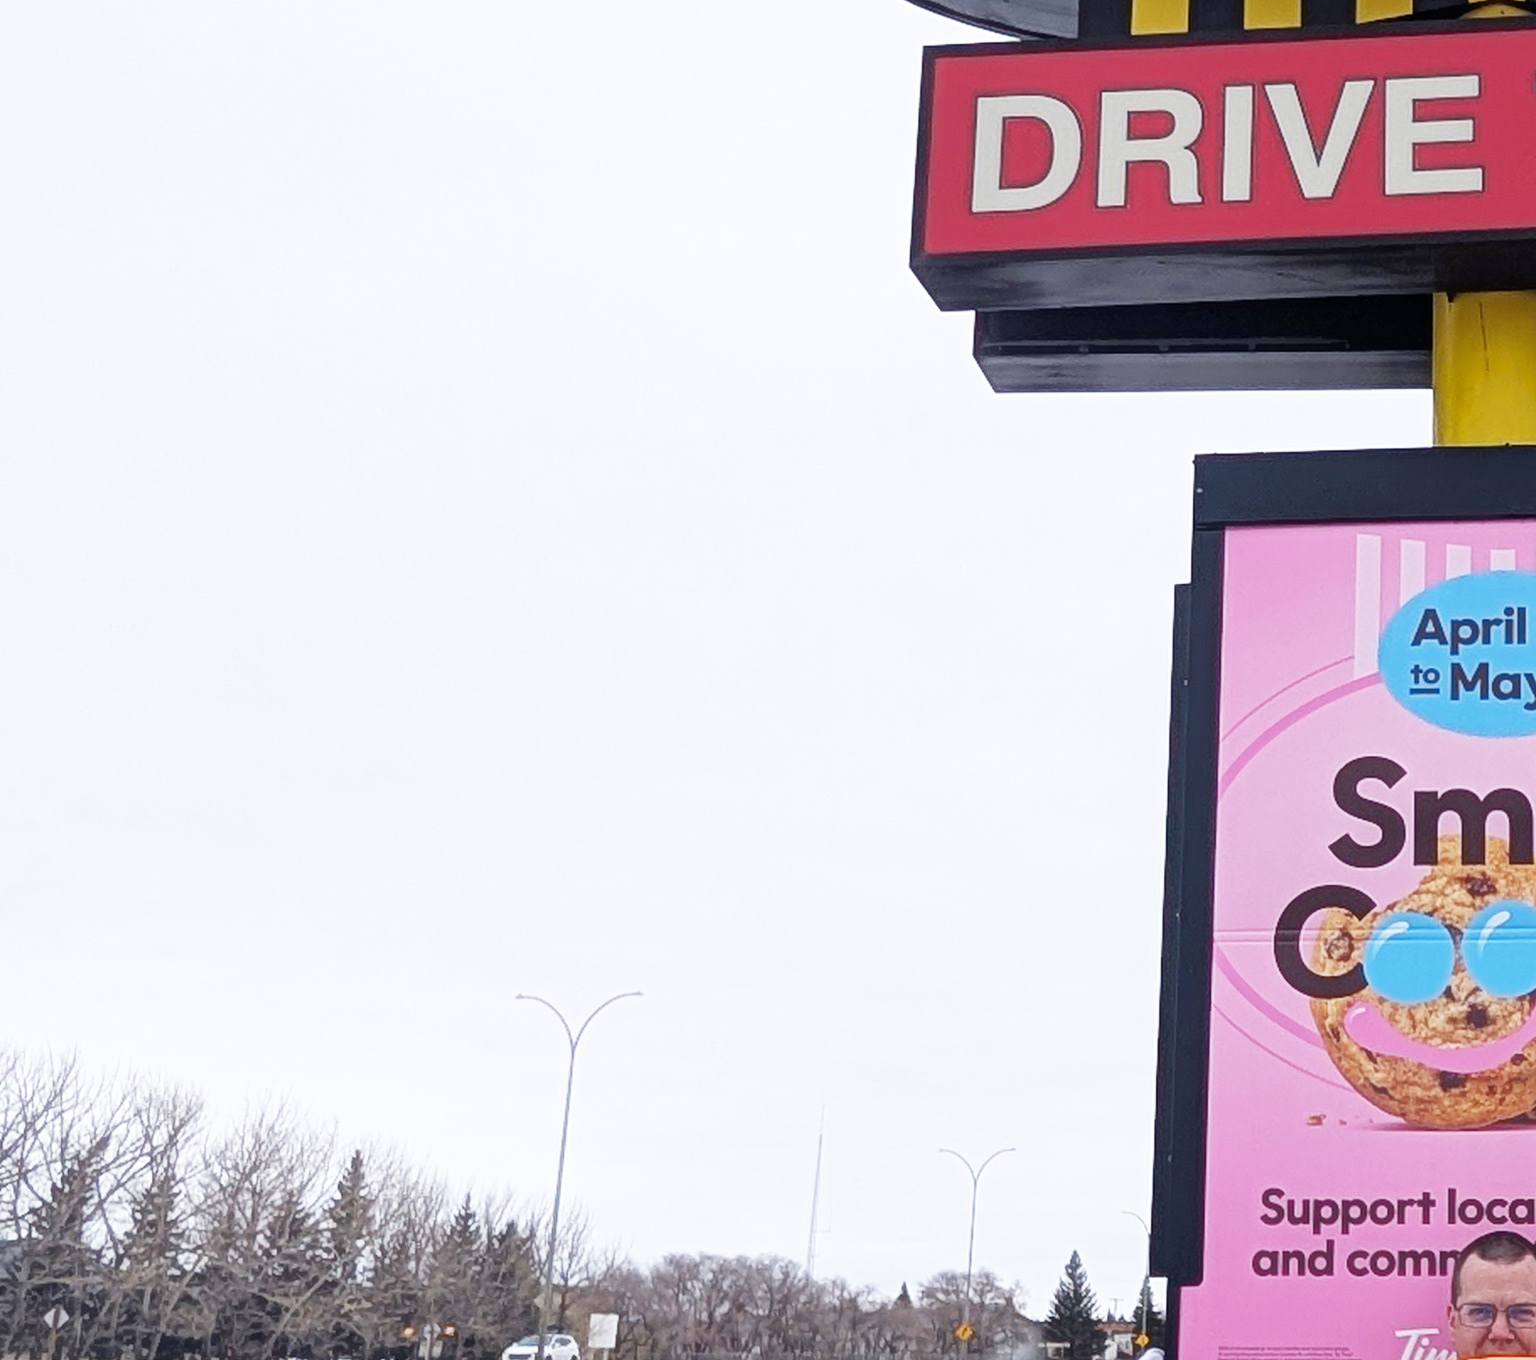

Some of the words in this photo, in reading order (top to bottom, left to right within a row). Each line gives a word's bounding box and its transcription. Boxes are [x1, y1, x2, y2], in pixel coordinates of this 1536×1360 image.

[970, 74, 1485, 214] DRIVE
[1410, 606, 1527, 656] April
[1410, 664, 1440, 686] to
[1260, 1187, 1436, 1234] Support
[1251, 1243, 1335, 1278] and
